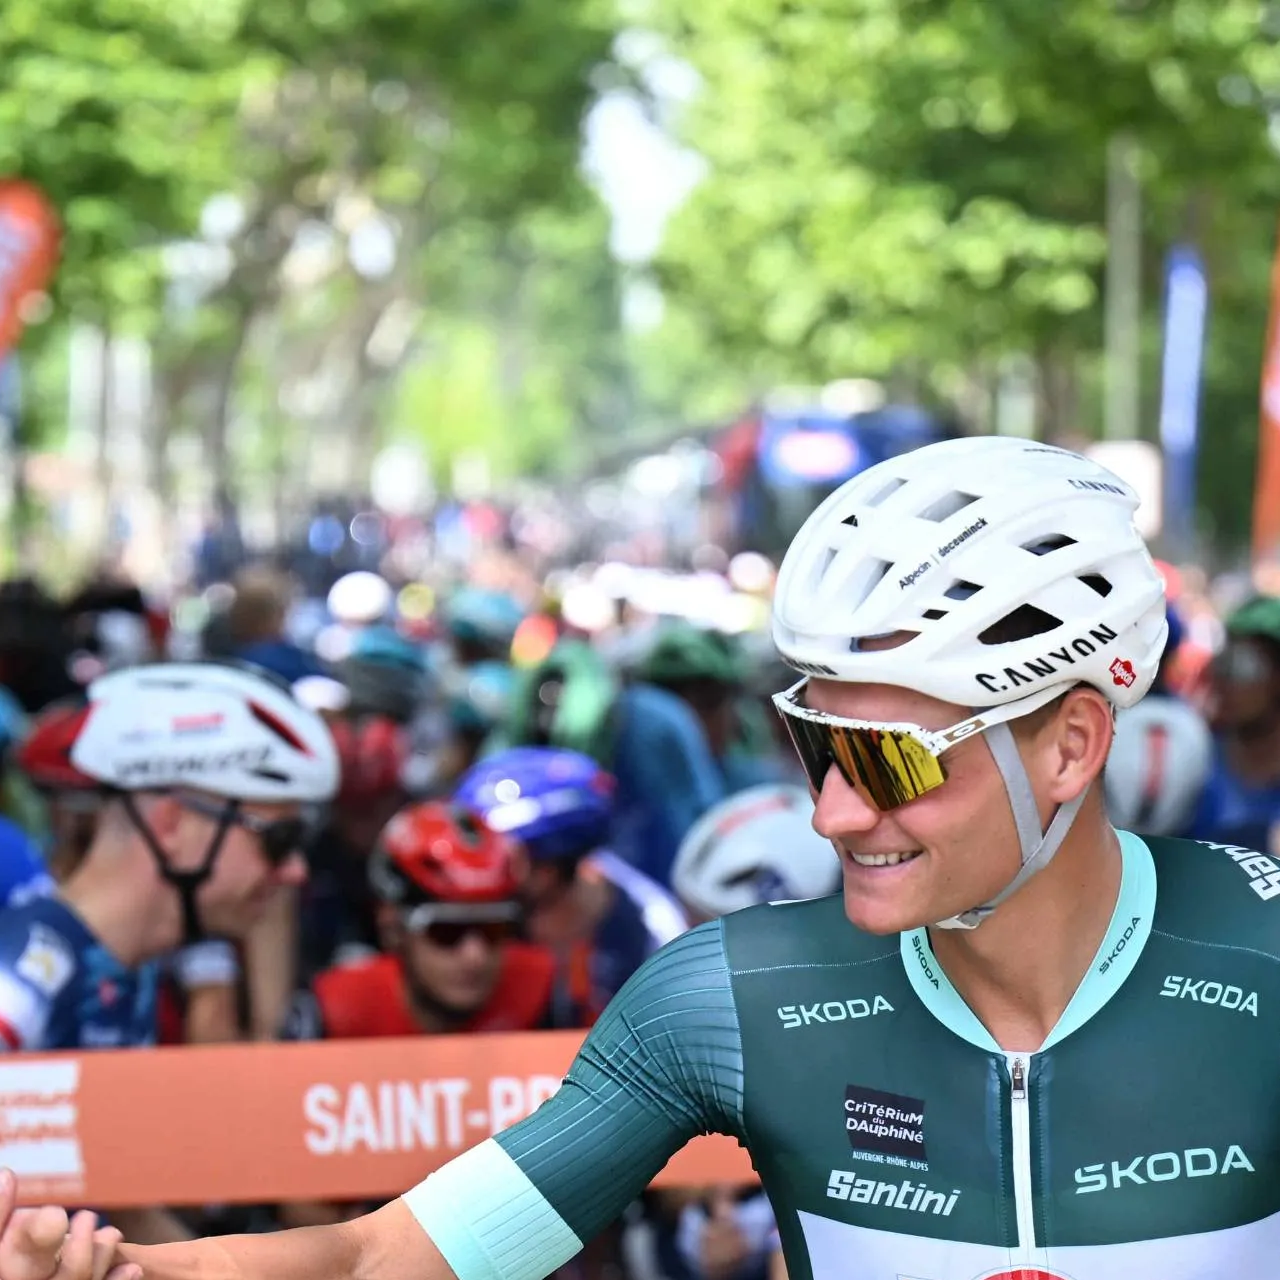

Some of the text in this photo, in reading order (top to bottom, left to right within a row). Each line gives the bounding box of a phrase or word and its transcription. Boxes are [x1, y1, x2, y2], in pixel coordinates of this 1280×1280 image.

[898, 517, 989, 591] Alpecin deceuninck
[975, 623, 1118, 693] CANYON
[911, 935, 940, 990] SKODA
[1098, 916, 1141, 975] SKODA
[777, 995, 895, 1029] SKODA
[1159, 976, 1259, 1017] SKODA
[872, 1116, 885, 1126] du
[826, 1169, 962, 1217] Santini
[1072, 1144, 1256, 1195] SKODA
